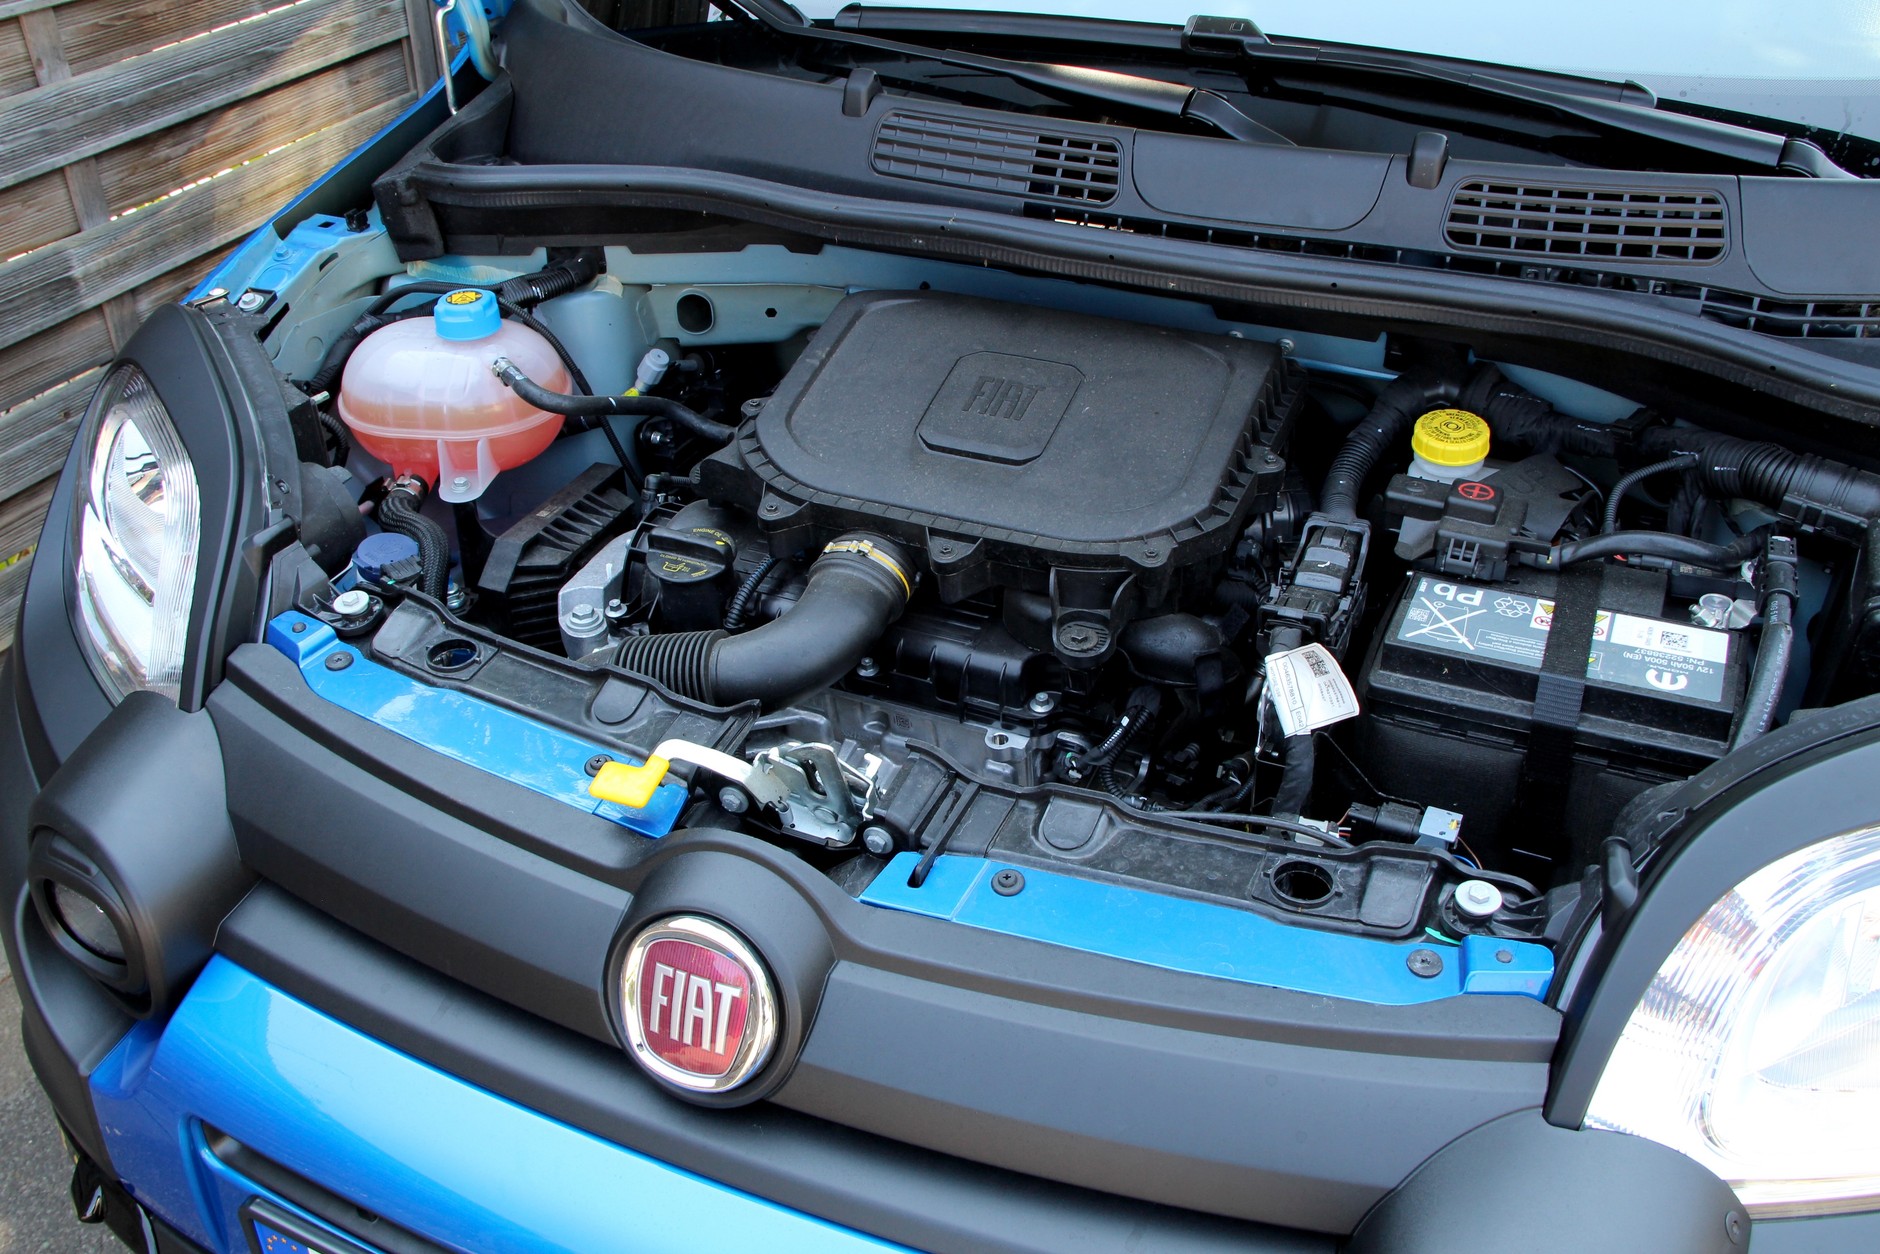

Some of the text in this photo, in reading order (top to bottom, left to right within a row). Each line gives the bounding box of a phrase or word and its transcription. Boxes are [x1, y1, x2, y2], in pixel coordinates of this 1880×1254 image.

[961, 376, 1047, 421] FIAT
[1433, 583, 1484, 606] Pb
[1644, 656, 1668, 665] 500A
[1671, 662, 1694, 671] 50Ah
[1696, 666, 1714, 674] 12V
[1282, 661, 1304, 728] 00463578810 E042
[650, 962, 743, 1056] FIAT
